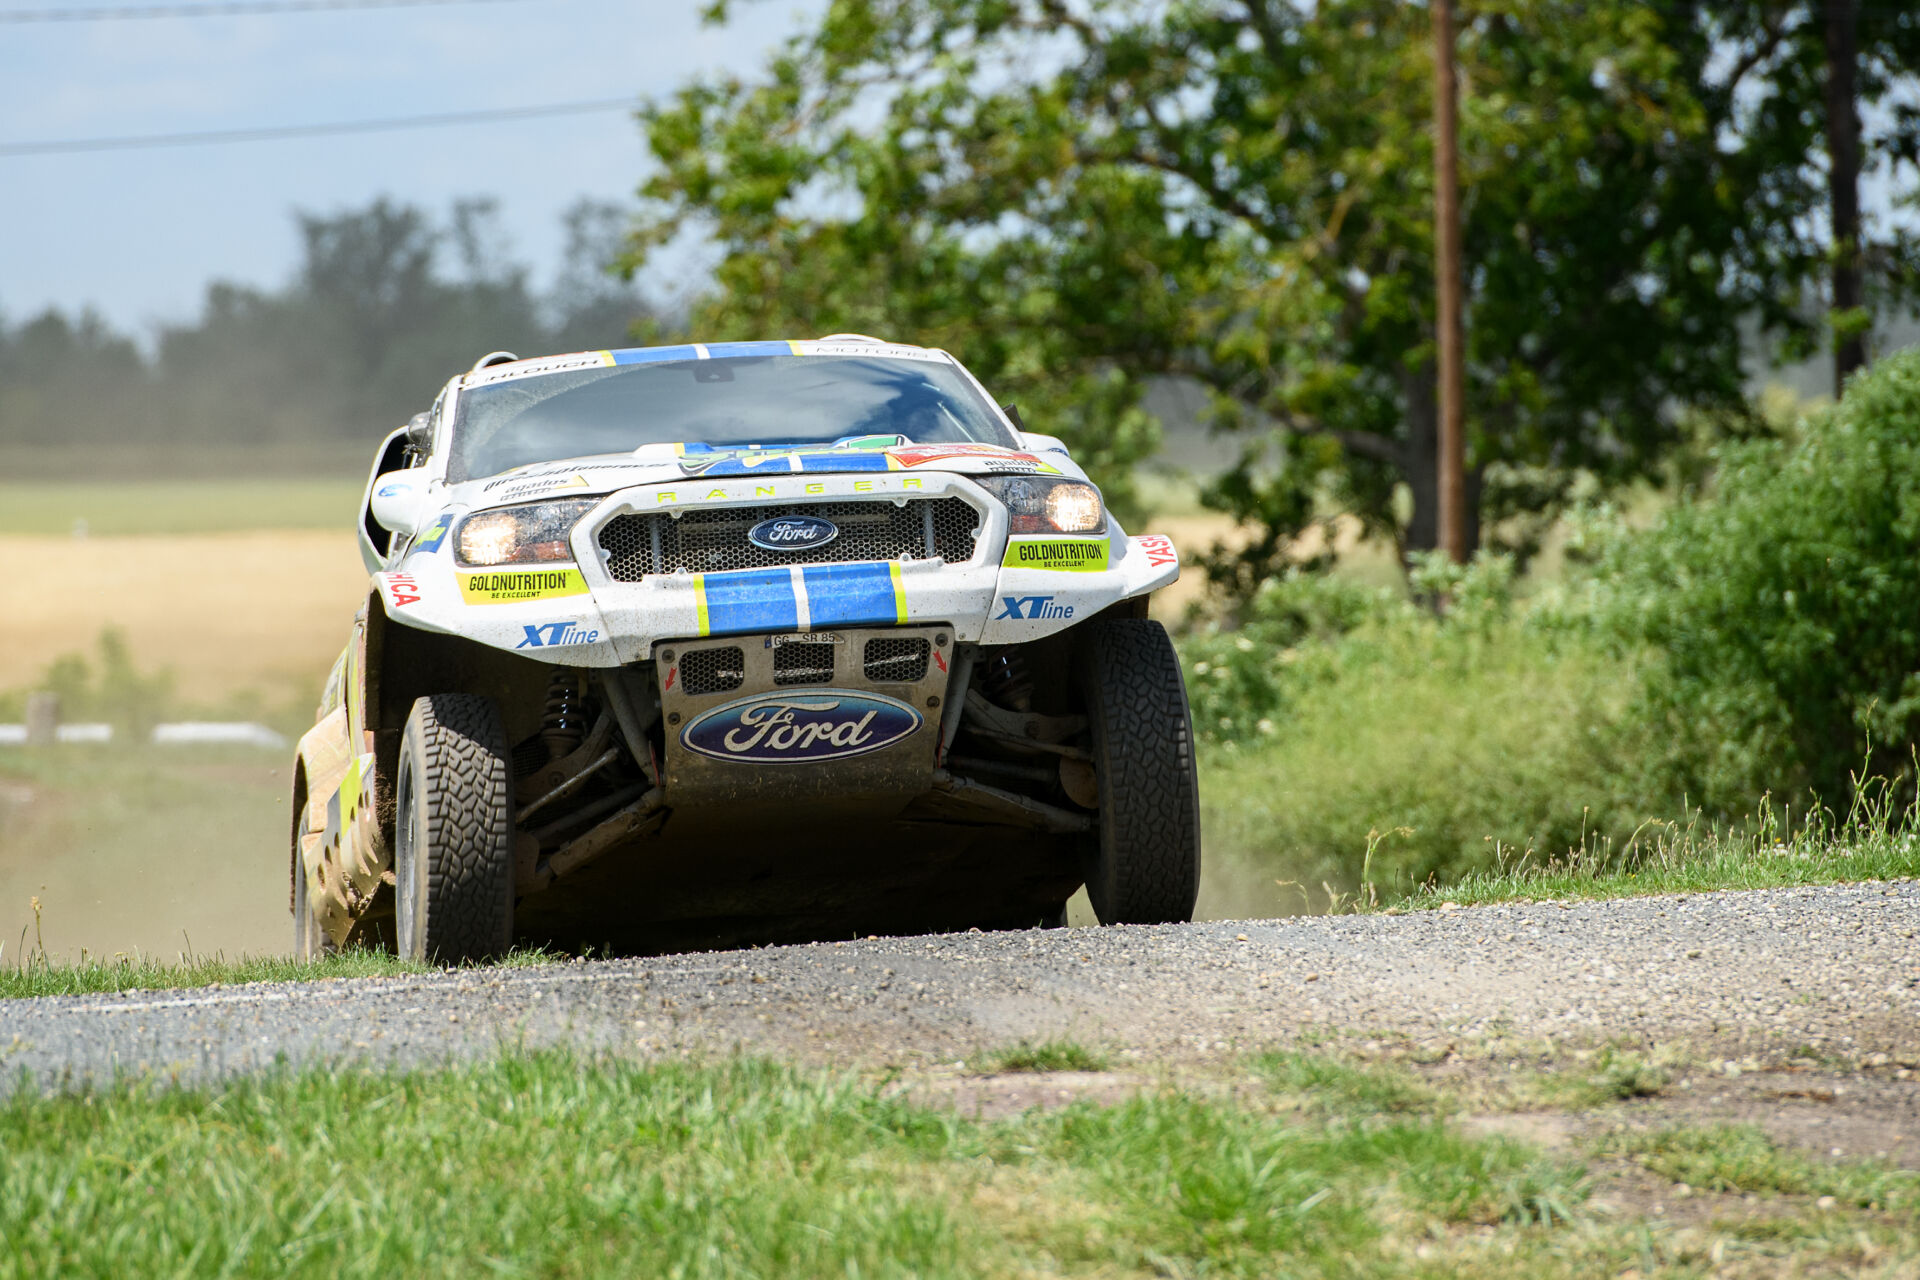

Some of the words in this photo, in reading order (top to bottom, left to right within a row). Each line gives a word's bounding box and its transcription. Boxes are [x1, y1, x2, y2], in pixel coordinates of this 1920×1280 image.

[657, 478, 923, 503] RANGER
[769, 520, 818, 541] Ford
[1019, 543, 1103, 561] GOLDNUTRITION
[1053, 560, 1085, 568] EXCELLENT
[469, 572, 567, 591] GOLDNUTRITION
[995, 595, 1074, 620] XTline
[516, 621, 599, 648] XTline
[821, 633, 836, 642] 85
[723, 701, 878, 753] Ford
